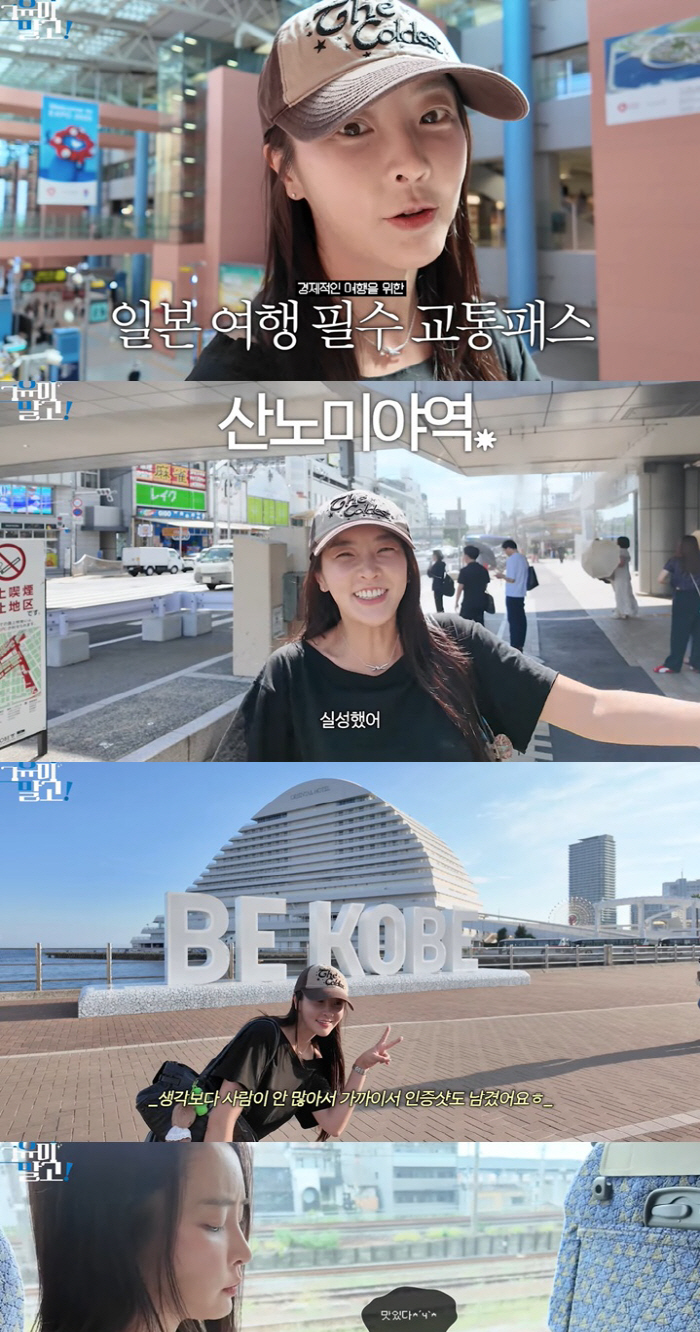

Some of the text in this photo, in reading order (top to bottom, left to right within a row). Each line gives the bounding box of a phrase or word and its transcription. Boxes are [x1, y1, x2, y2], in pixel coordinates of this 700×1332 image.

[313, 0, 395, 36] The
[150, 487, 177, 503] レイク
[165, 892, 478, 985] BE KOBE
